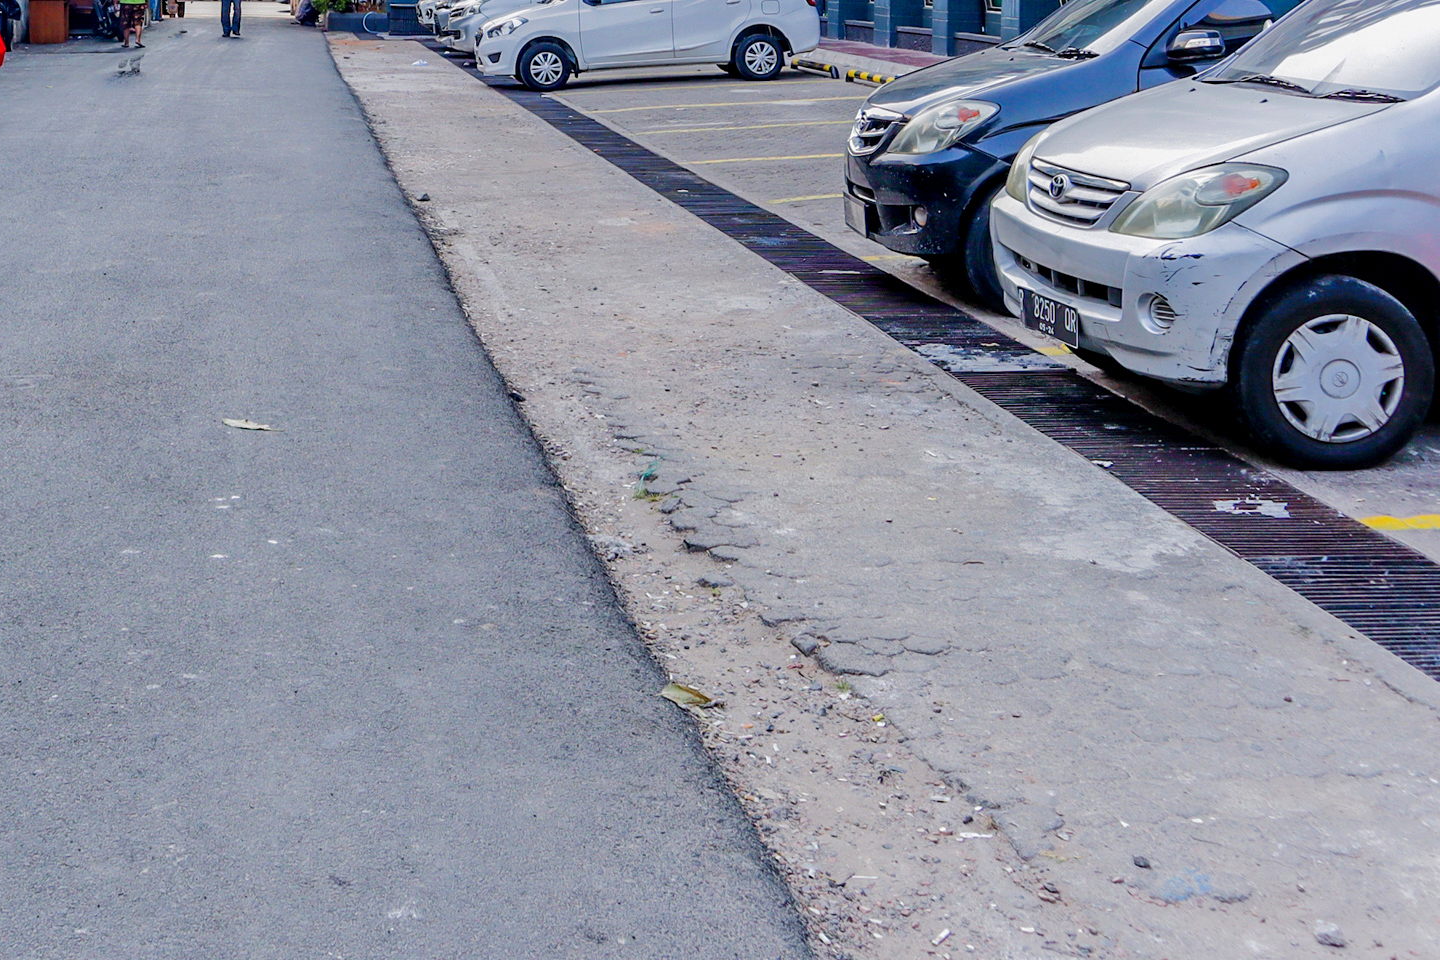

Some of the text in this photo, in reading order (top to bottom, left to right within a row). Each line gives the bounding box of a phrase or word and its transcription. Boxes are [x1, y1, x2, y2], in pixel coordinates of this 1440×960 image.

[1034, 295, 1055, 324] 8250
[1064, 307, 1077, 334] QR
[1039, 322, 1055, 335] 05-24
